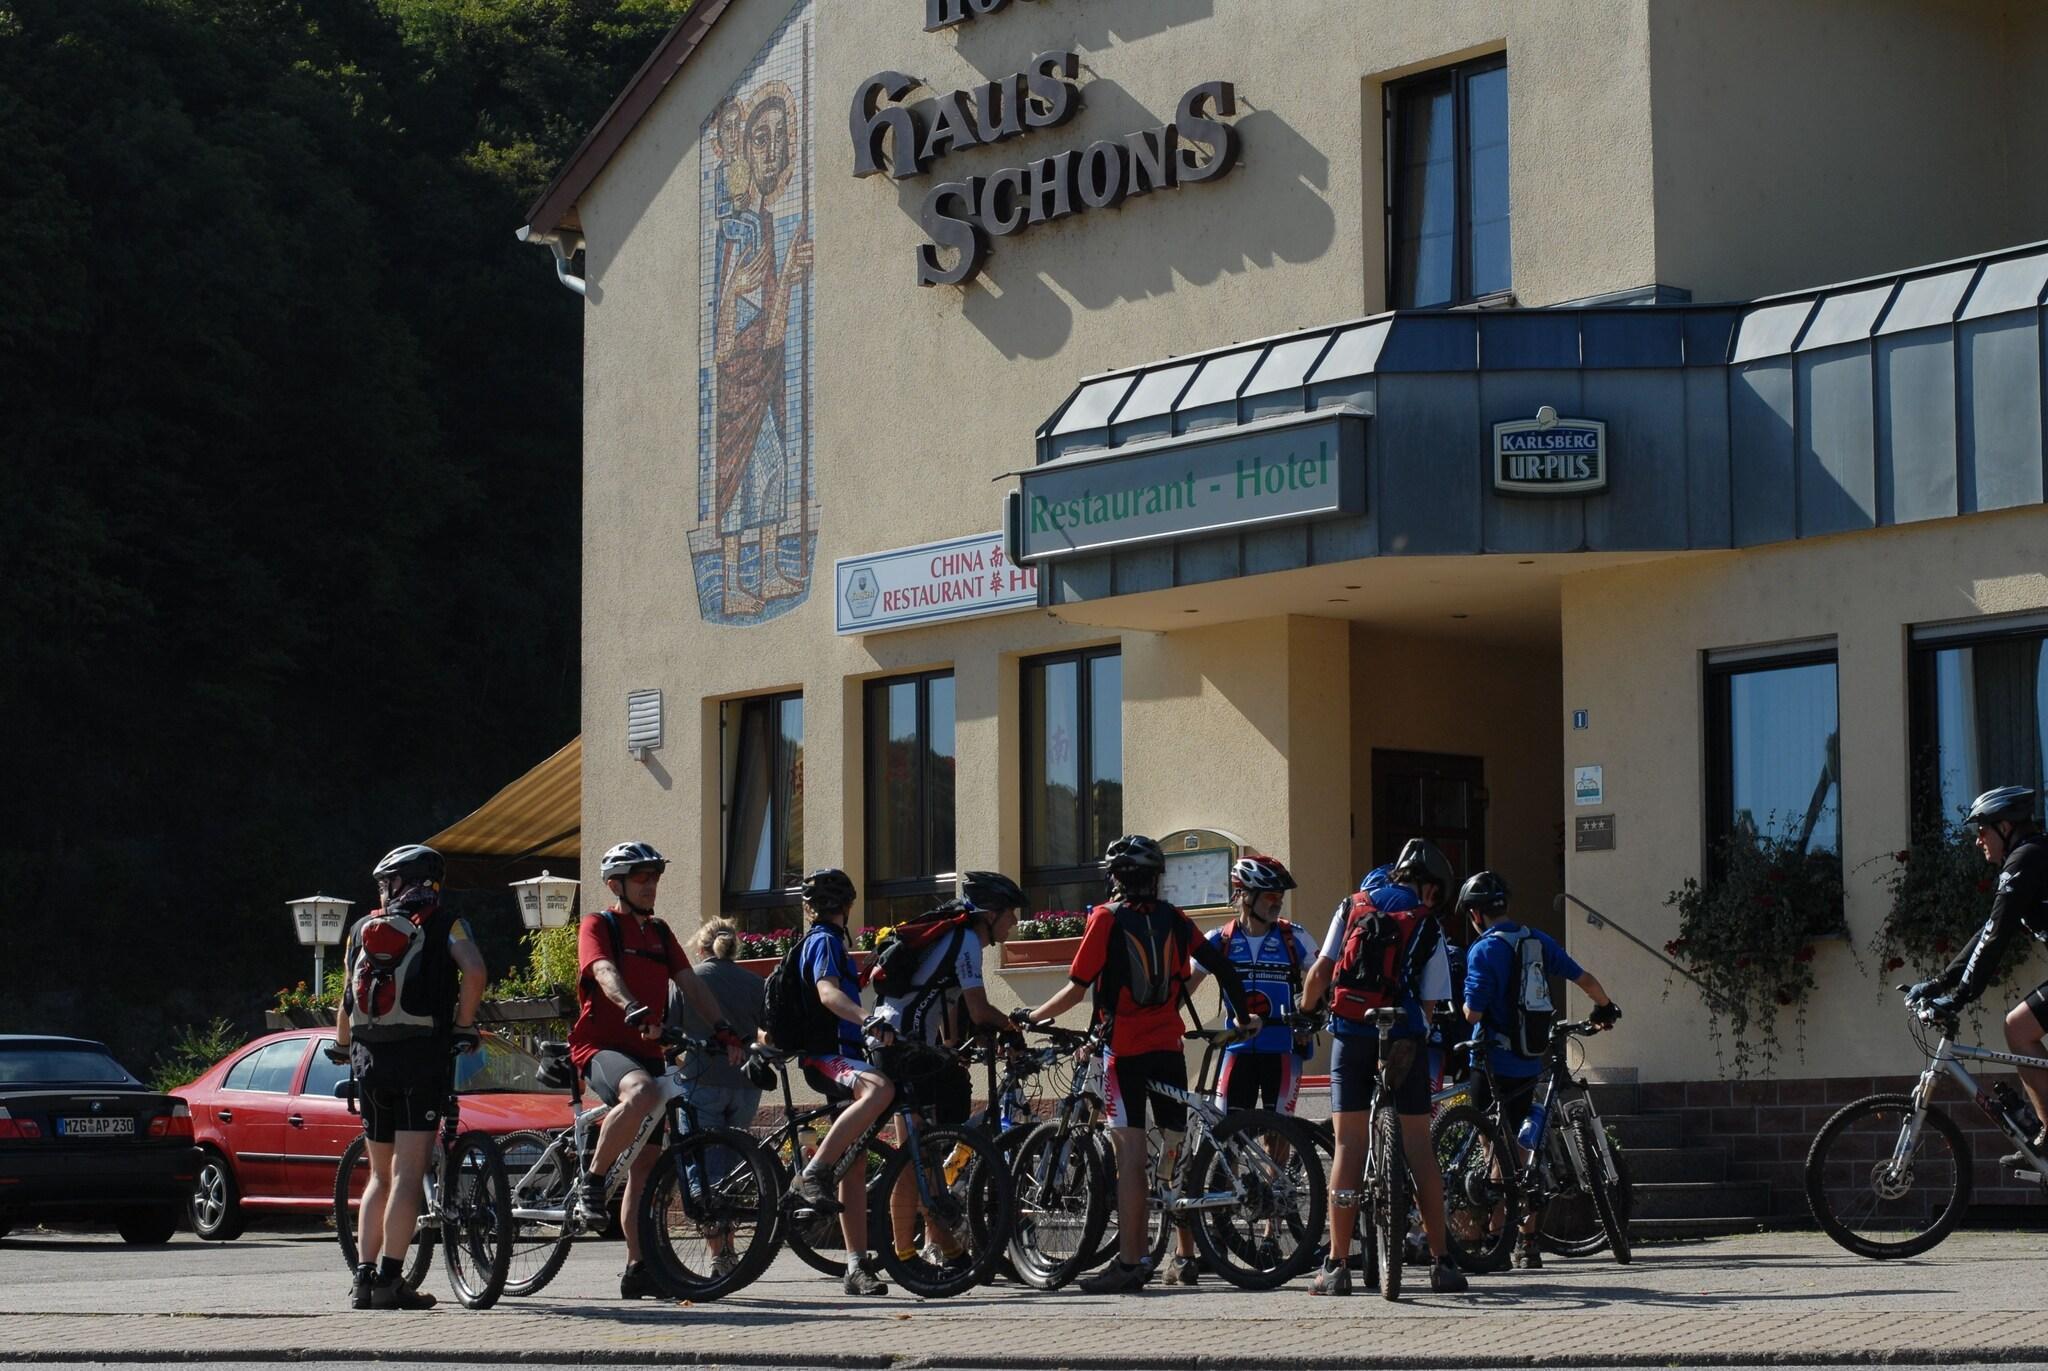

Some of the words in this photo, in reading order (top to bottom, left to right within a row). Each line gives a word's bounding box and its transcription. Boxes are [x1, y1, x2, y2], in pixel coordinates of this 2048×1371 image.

[916, 81, 1241, 287] SCHONS
[1502, 433, 1596, 450] KARLSBERG
[1509, 454, 1591, 480] UR-PILS
[1031, 476, 1196, 534] Restaurant
[1236, 441, 1328, 500] Hotel
[931, 550, 984, 579] CHINA
[883, 576, 985, 613] RESTAURANT
[64, 1118, 87, 1133] MZG
[96, 1118, 110, 1133] AP
[113, 1118, 134, 1133] 230
